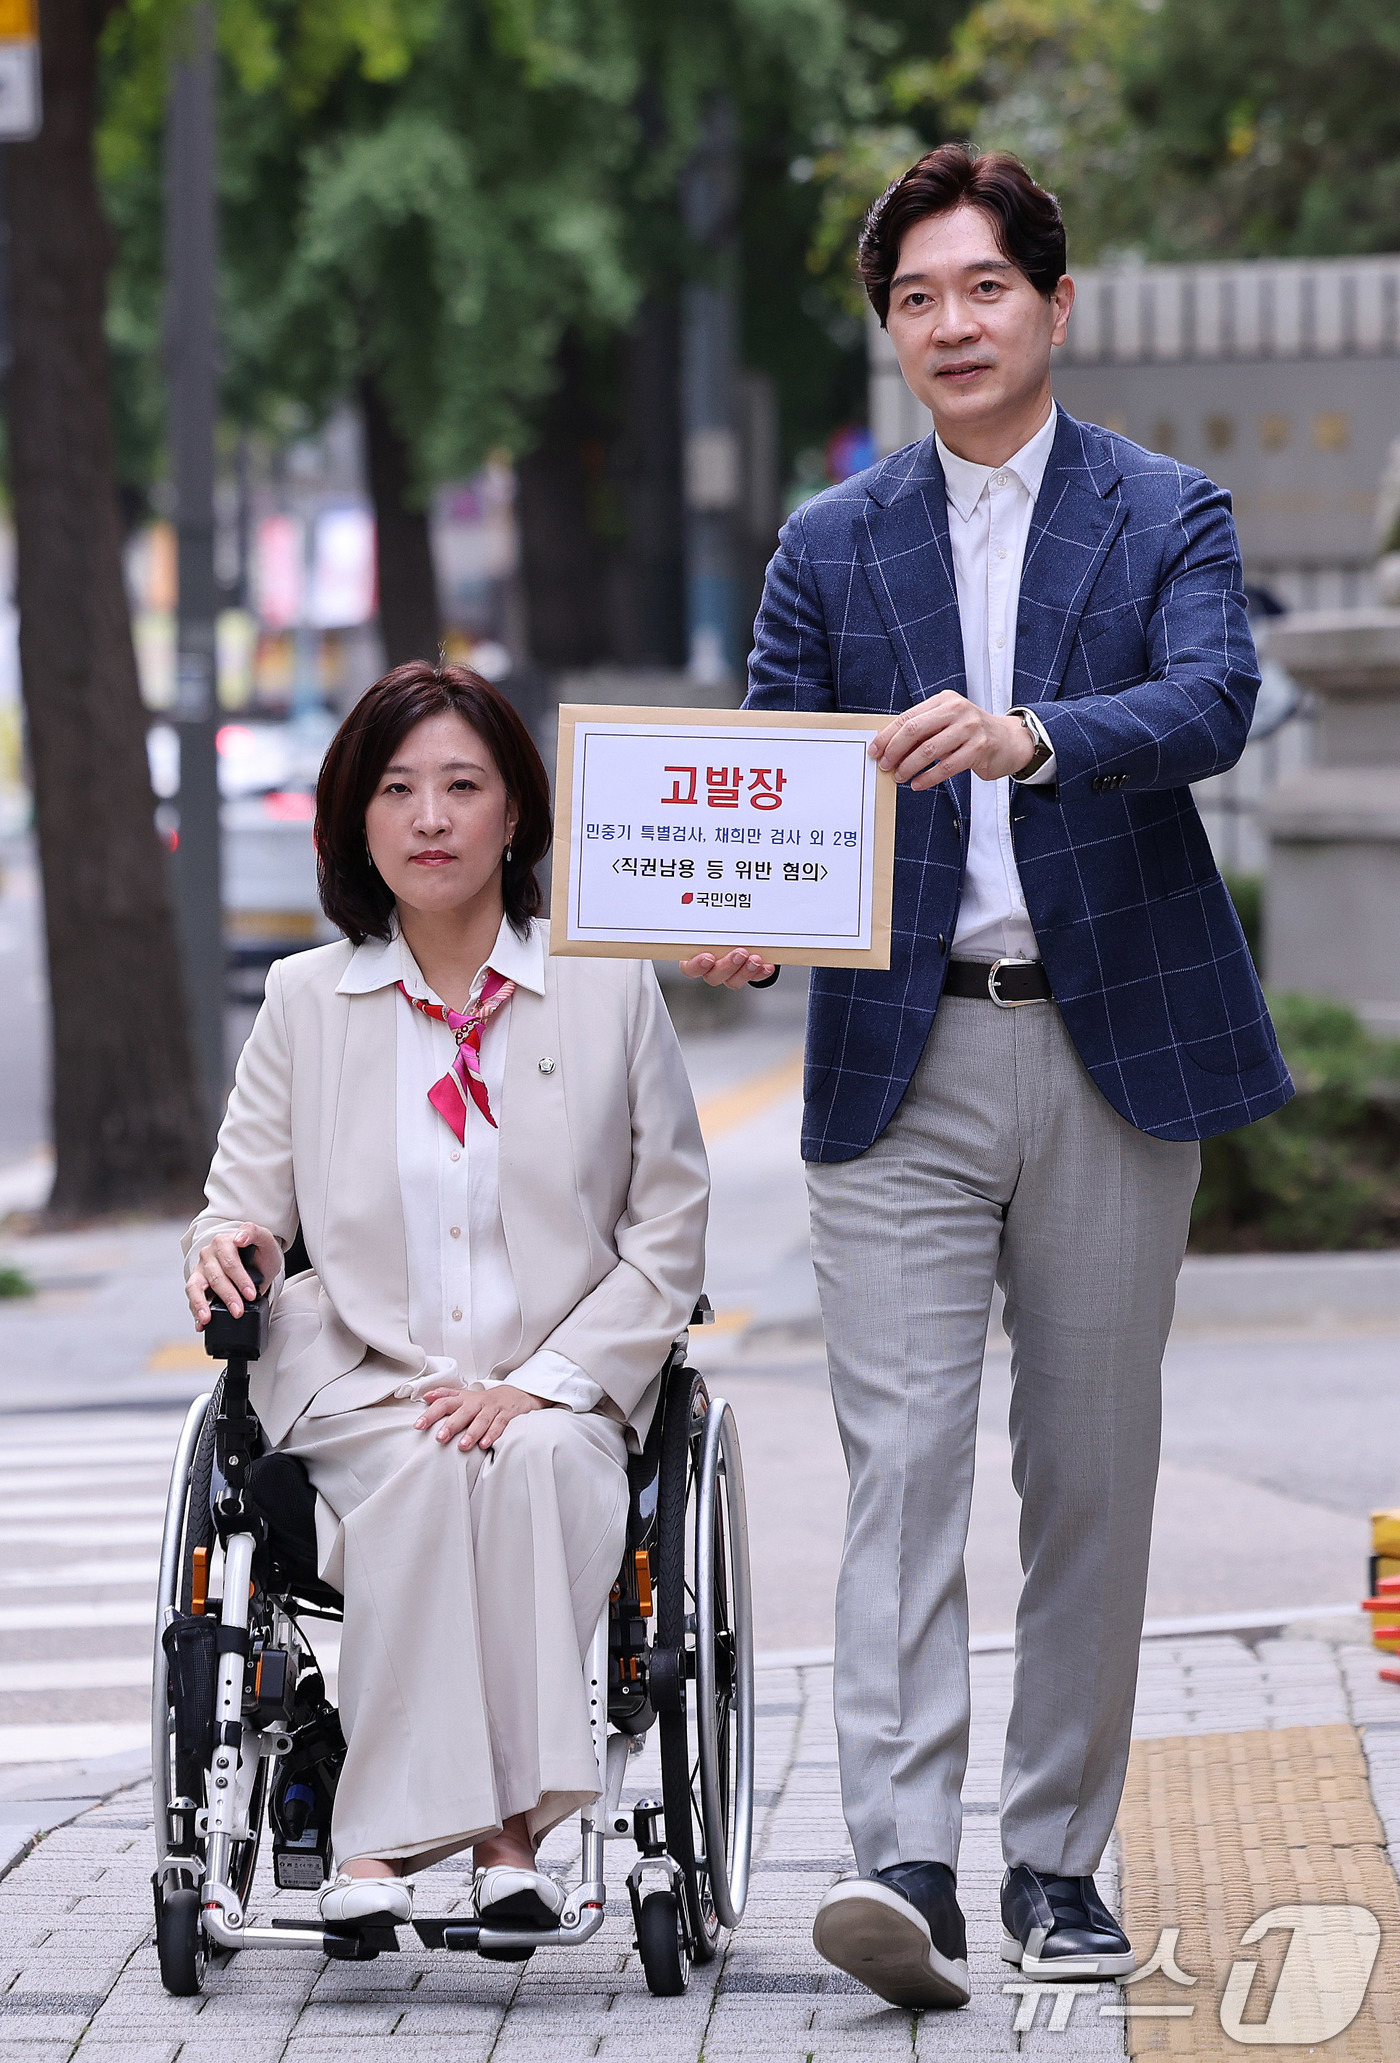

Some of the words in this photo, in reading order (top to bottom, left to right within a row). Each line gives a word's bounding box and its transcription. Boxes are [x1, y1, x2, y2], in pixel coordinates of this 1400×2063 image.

[660, 765, 787, 811] 고발장
[586, 823, 631, 840] 민중기
[641, 825, 706, 843] 특별검사,
[714, 827, 762, 844] 채희만
[770, 829, 801, 846] 검사
[809, 829, 824, 846] 외
[833, 831, 857, 848] 2명
[706, 860, 724, 879] 등
[735, 860, 772, 880] 위반
[696, 892, 752, 908] 국민의힘
